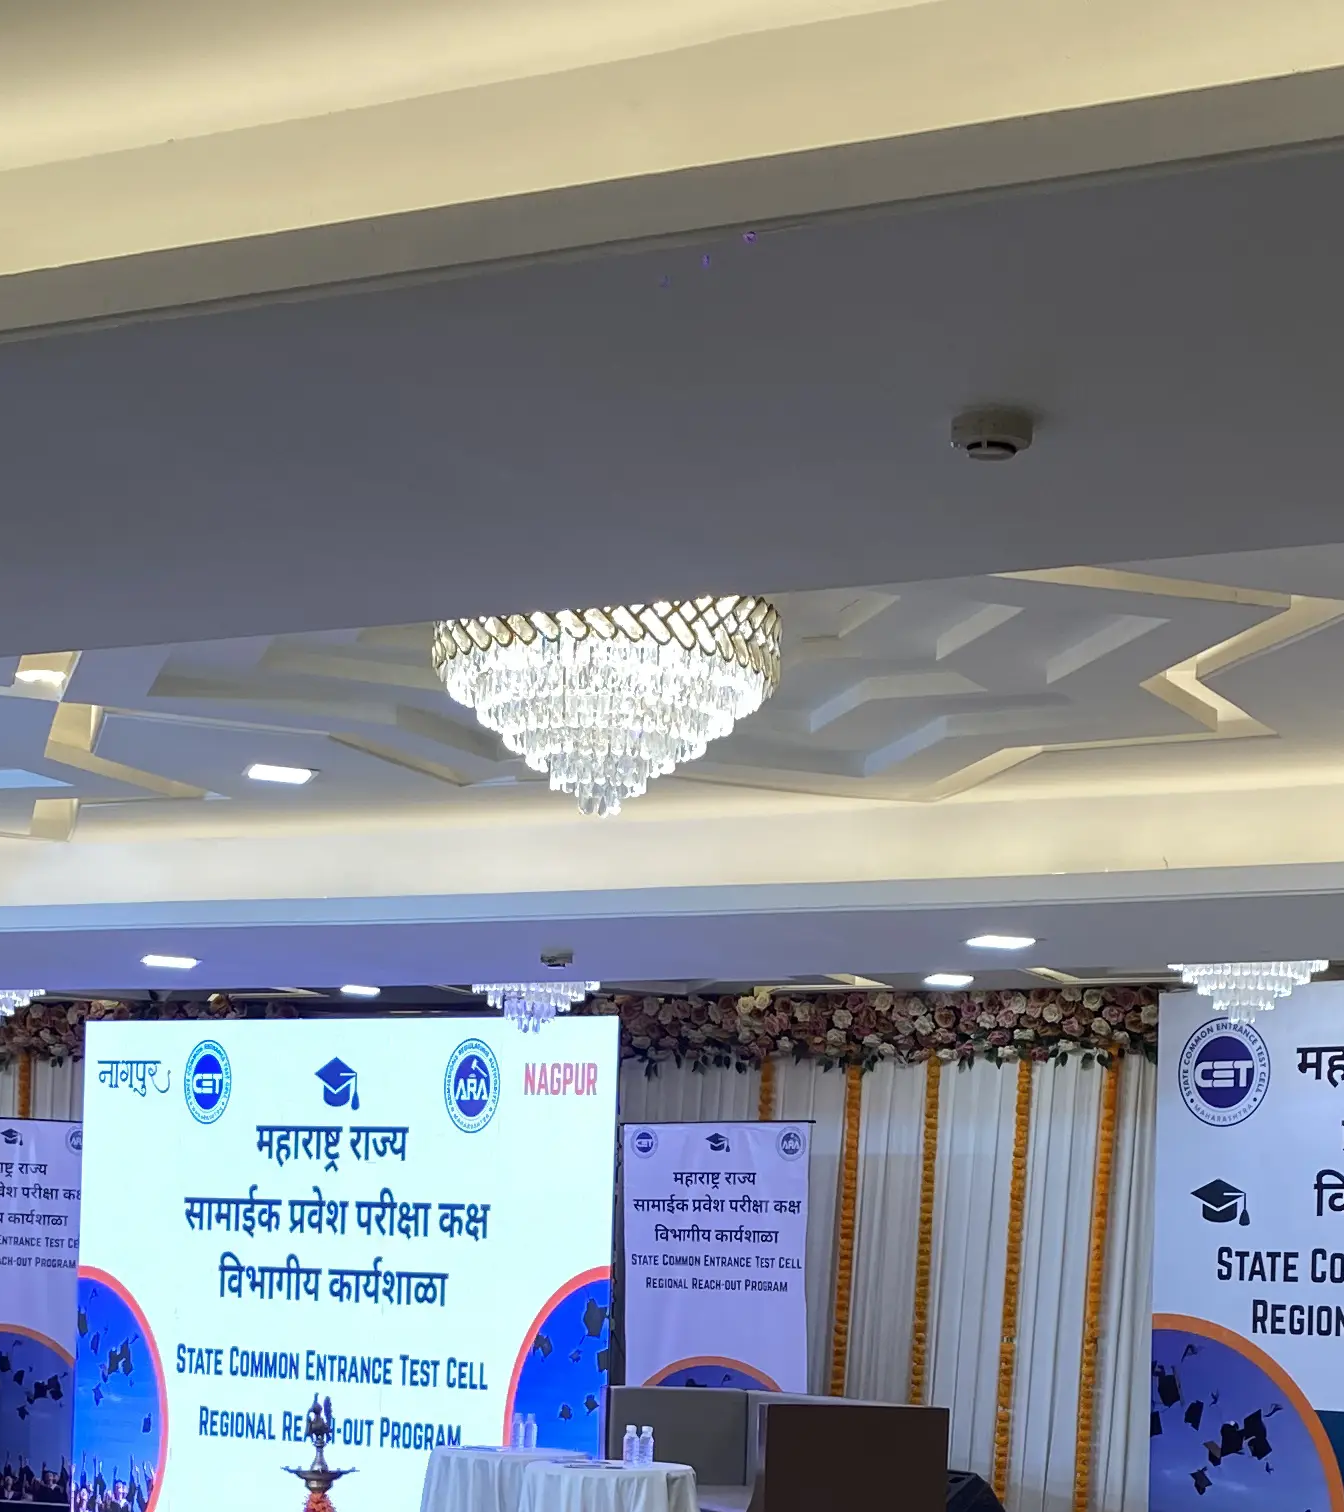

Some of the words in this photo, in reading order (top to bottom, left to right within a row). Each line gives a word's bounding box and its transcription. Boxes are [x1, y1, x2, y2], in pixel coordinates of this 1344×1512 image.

[1184, 1026, 1214, 1065] COMMON
[1216, 1022, 1258, 1046] ENTRANCE
[1256, 1045, 1266, 1068] TEST
[524, 1062, 598, 1096] NAGPUR
[1182, 1069, 1192, 1097] STATE
[1195, 1060, 1254, 1088] CET
[255, 1124, 343, 1173] महाराष्ट्र
[349, 1124, 409, 1162] राज्य
[18, 1162, 48, 1176] राज्य
[672, 1171, 721, 1190] महाराष्ट्र
[724, 1171, 757, 1186] राज्य
[21, 1183, 59, 1201] परीक्षा
[183, 1183, 282, 1239] सामाईक
[287, 1185, 349, 1236] प्रवेश
[355, 1187, 431, 1240] परीक्षा
[438, 1202, 491, 1242] कक्ष
[633, 1194, 689, 1214] सामाईक
[691, 1194, 725, 1213] प्रवेश
[729, 1195, 769, 1214] परीक्षा
[773, 1200, 802, 1215] कक्ष
[7, 1208, 68, 1227] कार्यशाळा
[45, 1236, 65, 1249] TEST
[67, 1237, 80, 1249] CE
[654, 1223, 712, 1243] विभागीय
[714, 1225, 779, 1244] कार्यशाळा
[34, 1256, 77, 1269] PROGRAM
[631, 1253, 659, 1266] STATE
[662, 1254, 701, 1267] COMMON
[703, 1255, 752, 1268] ENTRANCE
[755, 1255, 776, 1269] TEST
[778, 1256, 803, 1270] CELL
[1216, 1245, 1300, 1283] STATE
[218, 1251, 323, 1302] विभागीय
[327, 1256, 449, 1308] कार्यशाळा
[646, 1276, 688, 1290] REGIONAL
[692, 1277, 741, 1291] REACH-OUT
[744, 1279, 788, 1292] PROGRAM
[176, 1343, 223, 1376] STATE
[229, 1346, 299, 1380] COMMON
[305, 1350, 392, 1386] ENTRANCE
[399, 1354, 440, 1389] TEST
[446, 1356, 488, 1391] CELL
[199, 1404, 276, 1440] REGIONAL
[282, 1410, 375, 1447] REAH-OUT
[380, 1416, 462, 1450] PROGRAM
